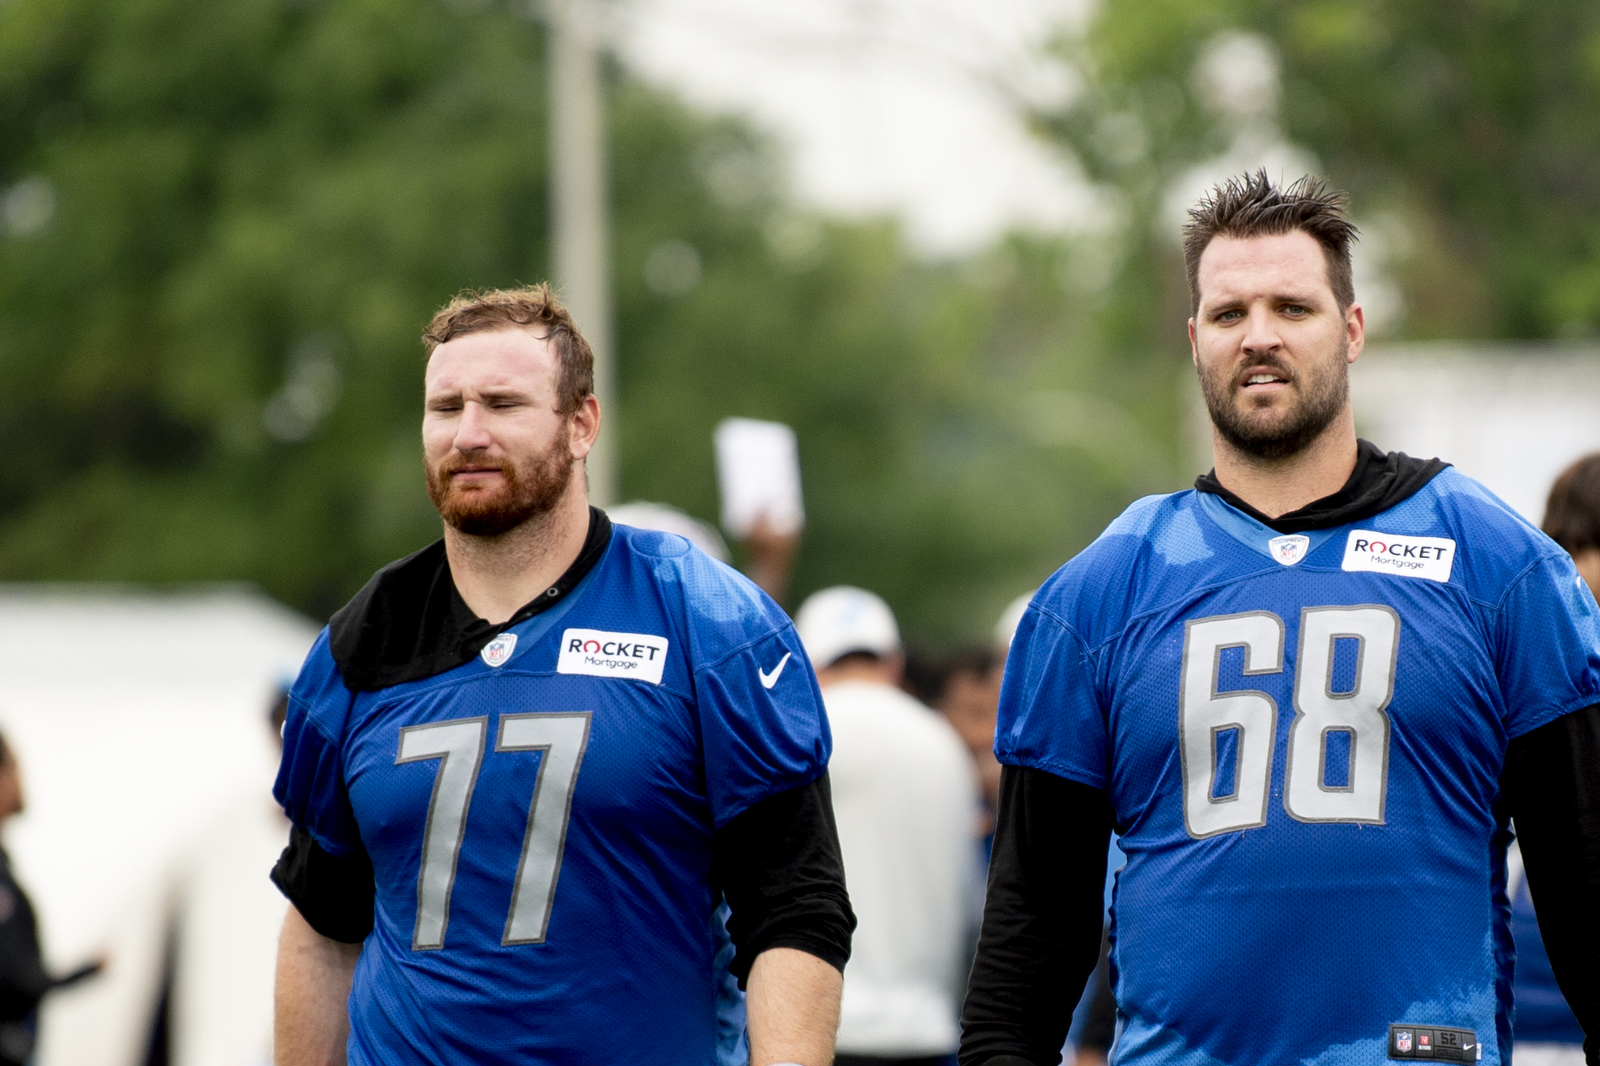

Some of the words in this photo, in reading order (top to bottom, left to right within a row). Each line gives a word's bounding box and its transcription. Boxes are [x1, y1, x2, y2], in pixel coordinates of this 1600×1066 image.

[1354, 539, 1447, 560] ROCKET
[1370, 555, 1425, 570] Mortgage
[568, 638, 660, 661] ROCKET
[584, 656, 638, 670] Mortgage
[1178, 603, 1401, 840] 68
[395, 711, 593, 951] 77
[1440, 1031, 1457, 1046] 52
